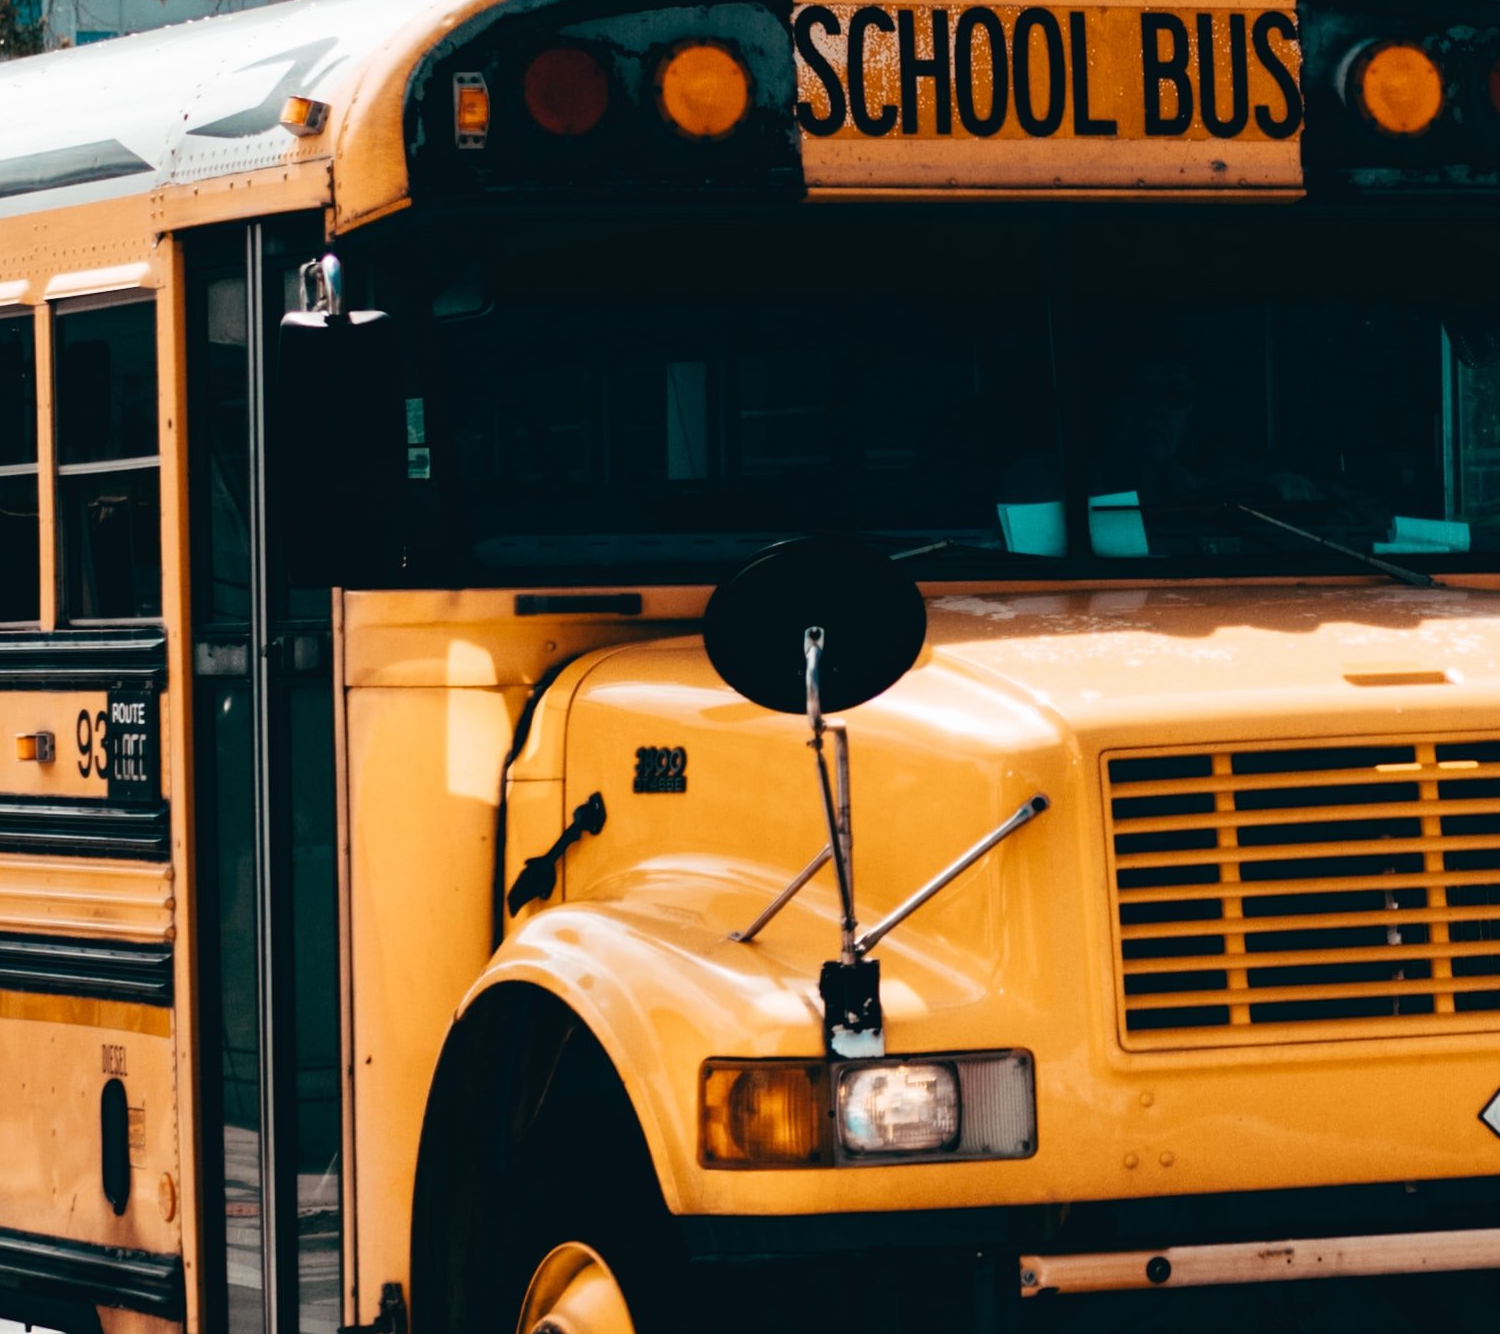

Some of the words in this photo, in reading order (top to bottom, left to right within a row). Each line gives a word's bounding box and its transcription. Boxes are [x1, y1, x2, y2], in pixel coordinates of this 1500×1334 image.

[793, 5, 1118, 138] SCHOOL
[1140, 10, 1304, 140] BUS
[111, 702, 146, 725] ROUTE
[101, 1043, 129, 1077] DIESEL
